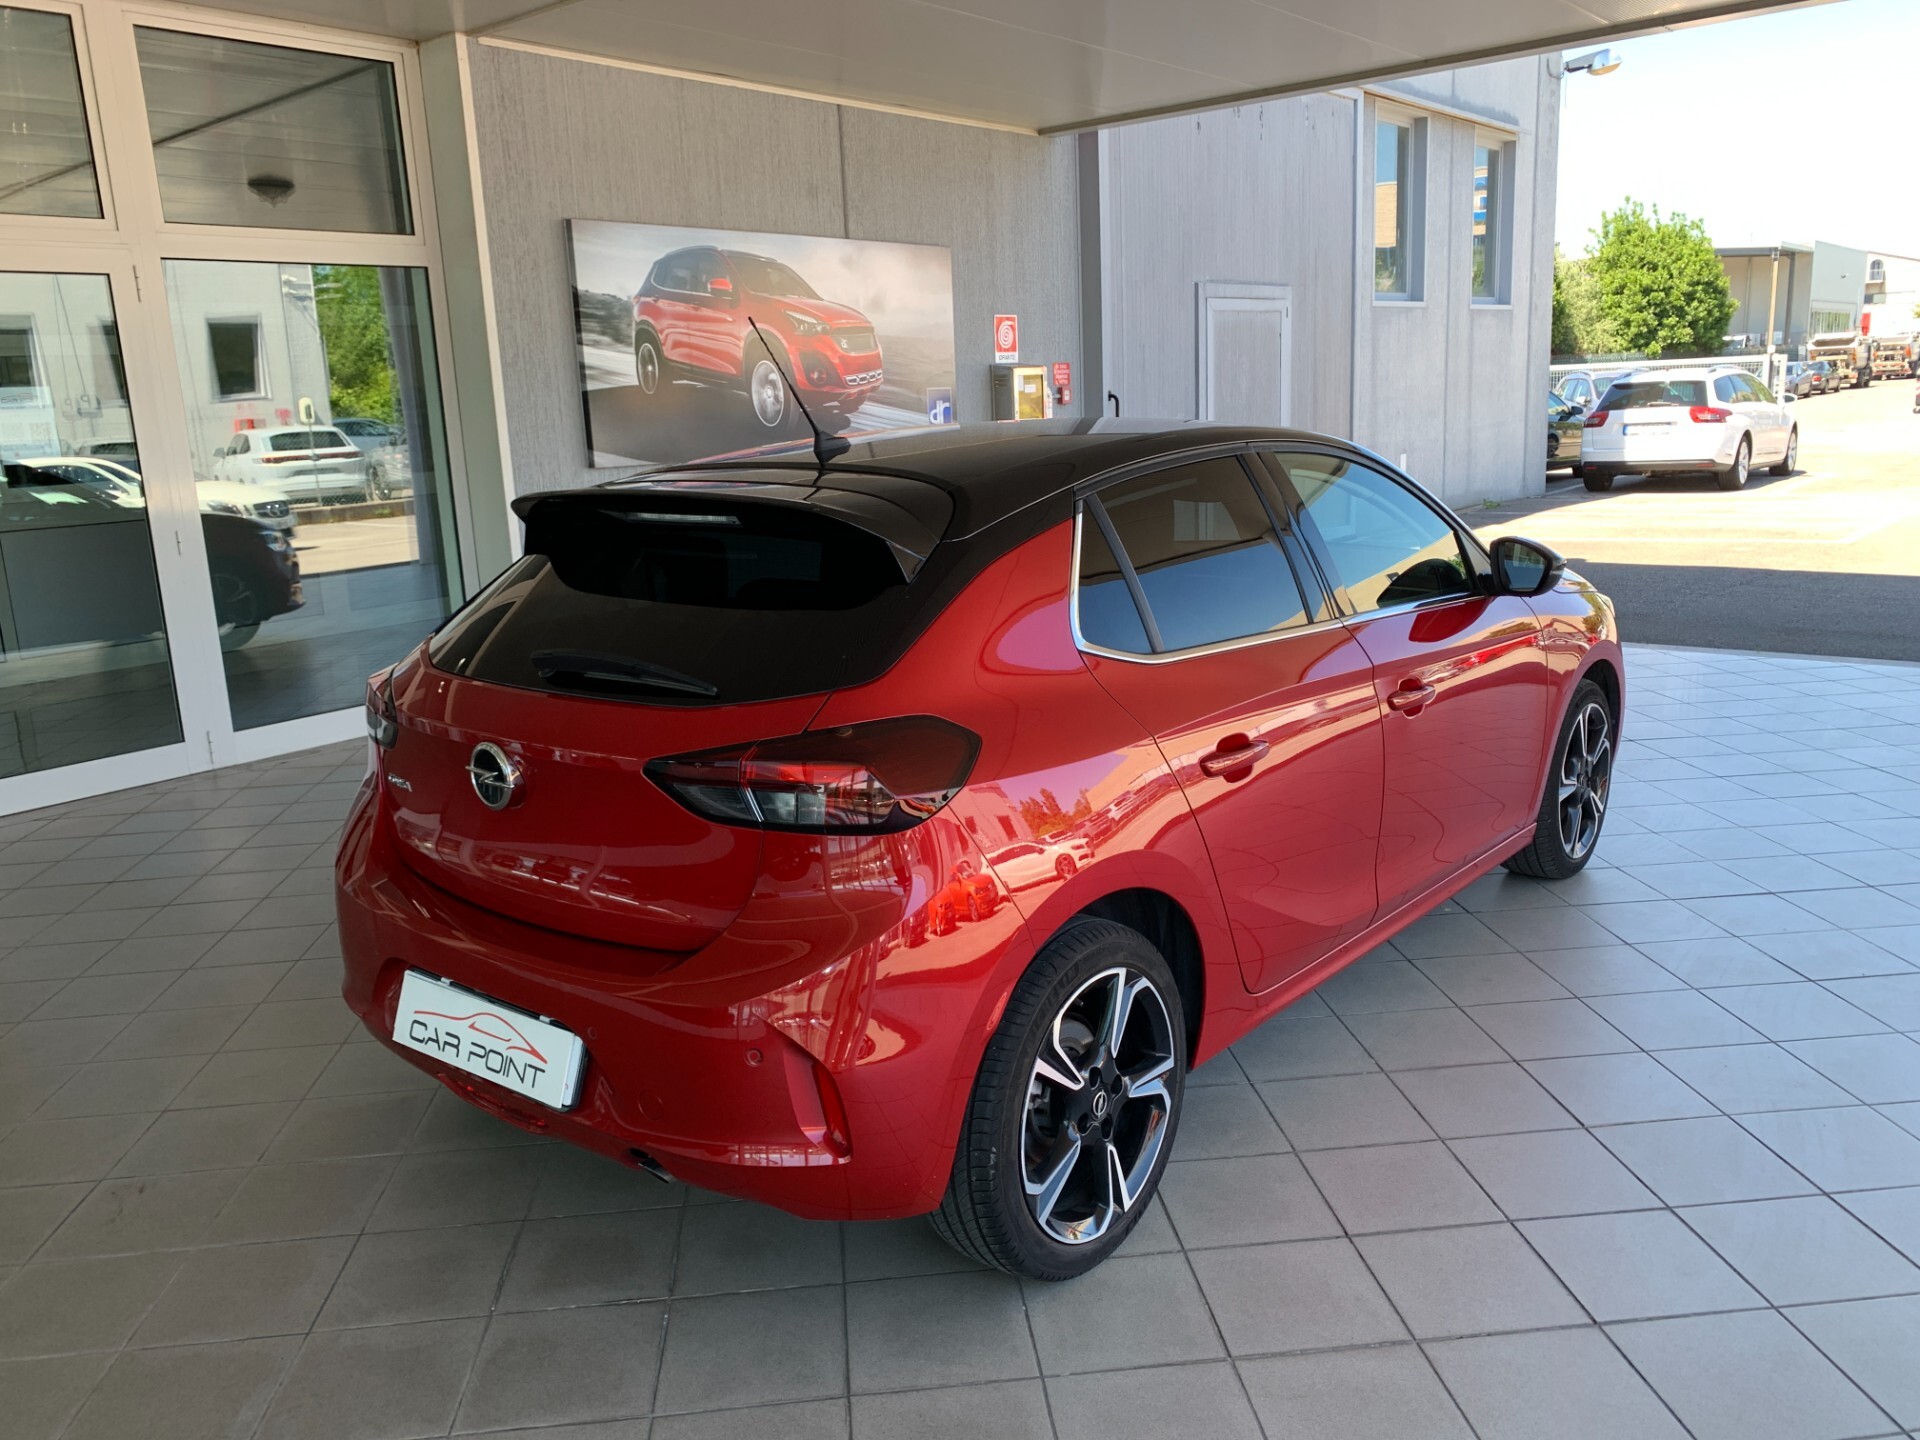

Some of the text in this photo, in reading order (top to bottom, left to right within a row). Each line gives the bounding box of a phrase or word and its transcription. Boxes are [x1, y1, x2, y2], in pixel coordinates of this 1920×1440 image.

[930, 400, 951, 424] dr
[409, 1019, 546, 1088] CAR POINT
